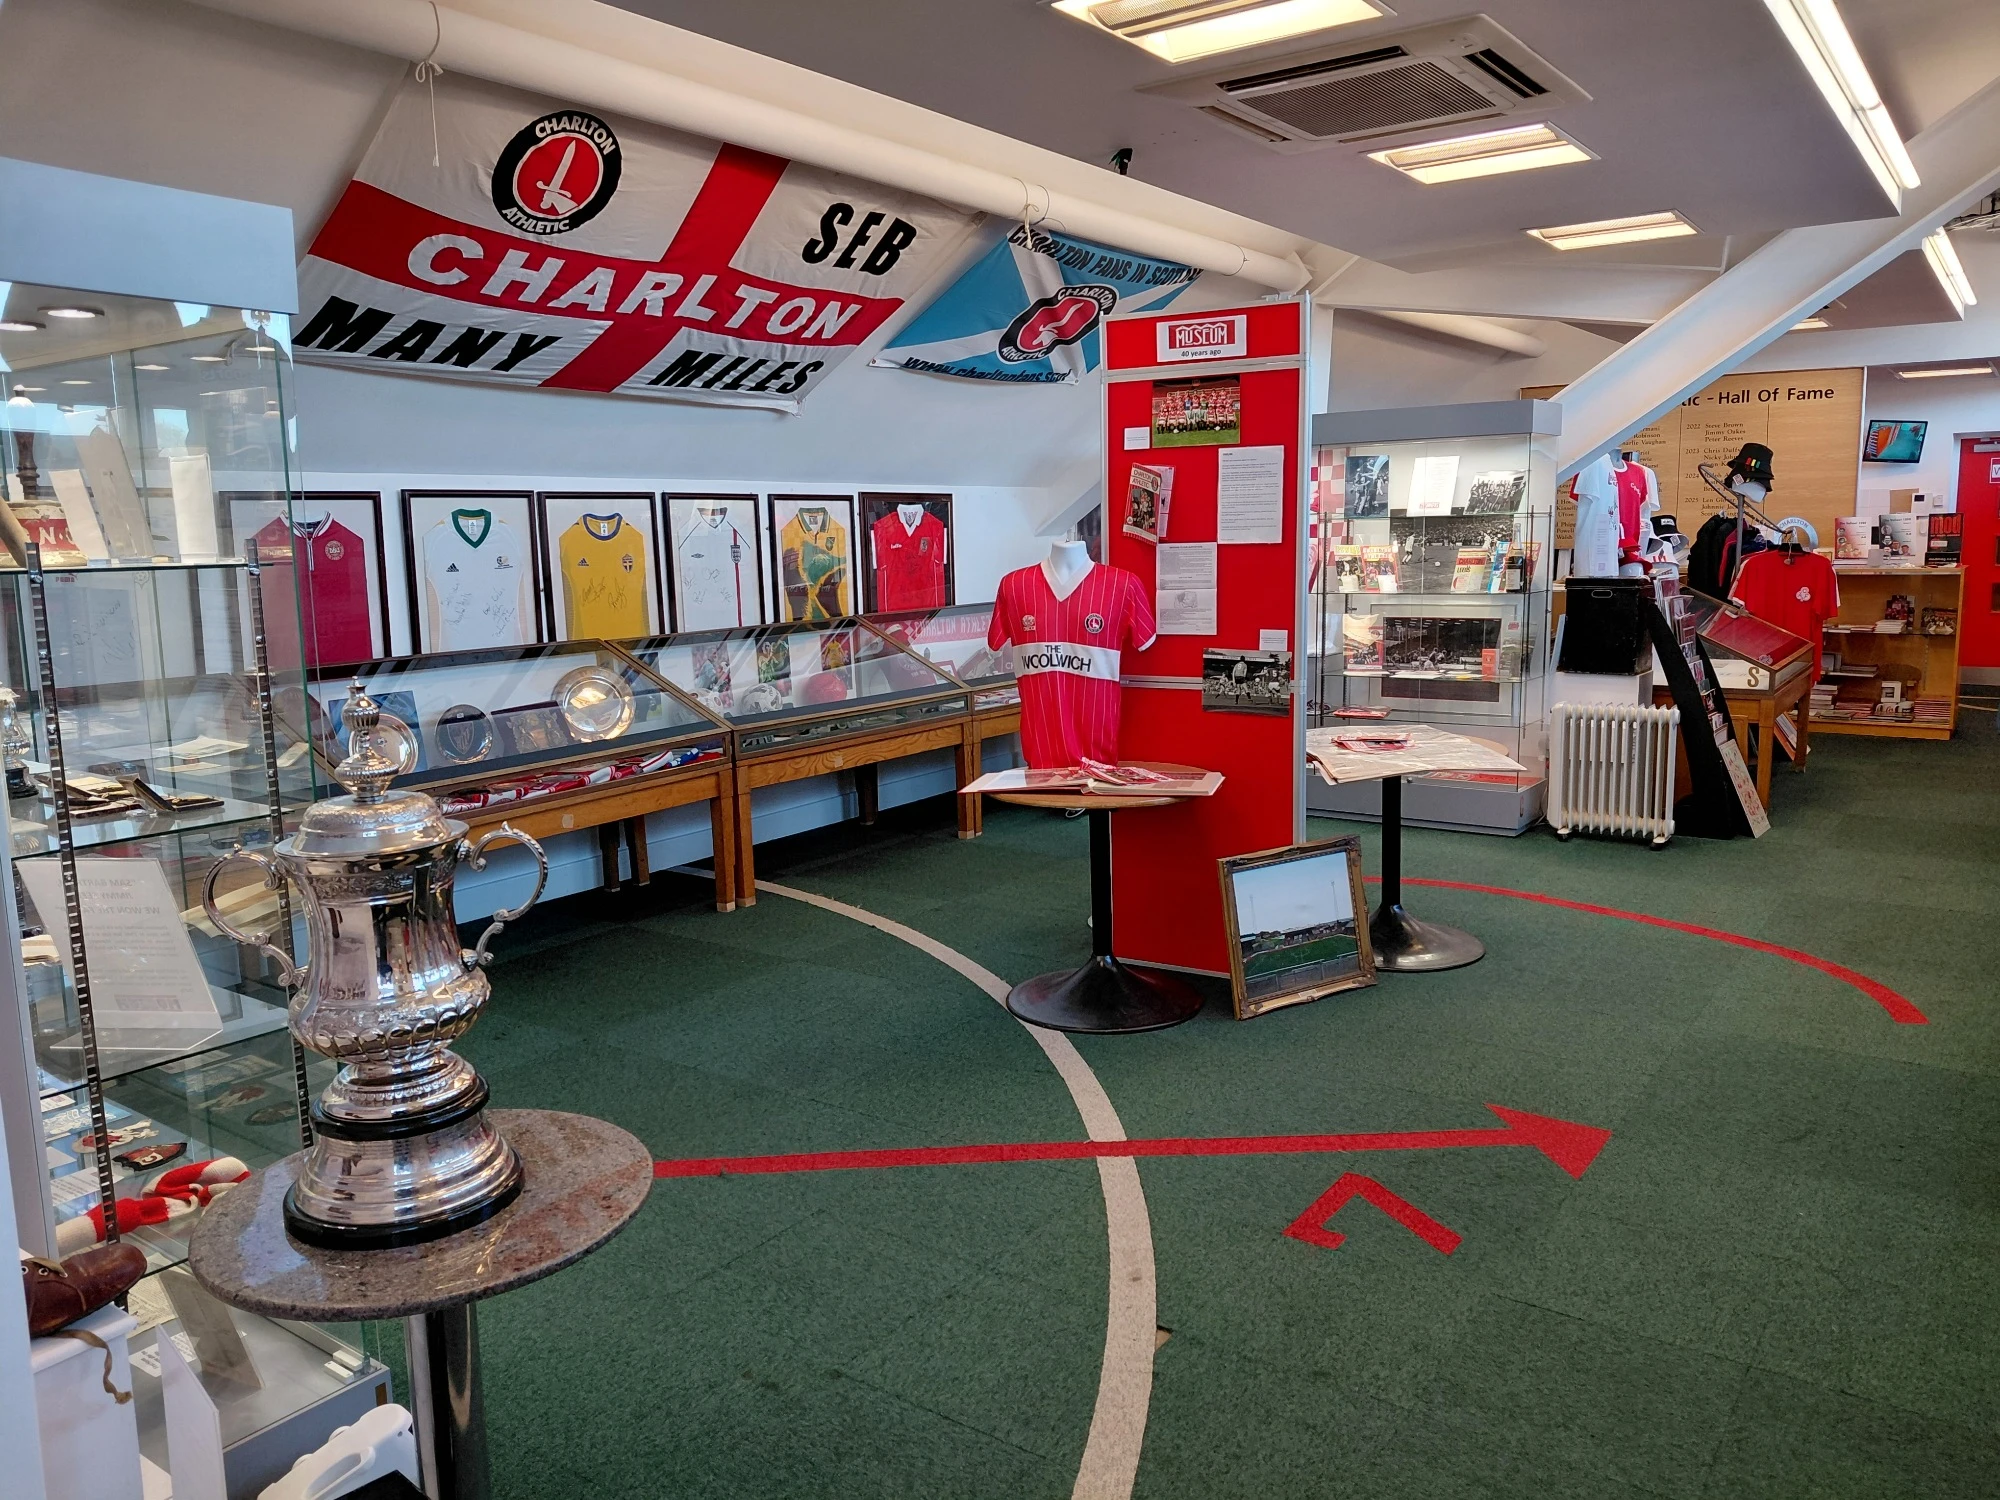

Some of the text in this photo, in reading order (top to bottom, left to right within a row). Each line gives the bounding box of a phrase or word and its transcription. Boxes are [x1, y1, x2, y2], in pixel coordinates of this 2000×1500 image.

[535, 115, 616, 156] CHARLTON
[501, 206, 570, 234] ATHLETIC
[802, 200, 917, 276] SEB
[1007, 225, 1096, 271] CHARLTON
[1088, 254, 1133, 281] FANS
[1127, 262, 1152, 283] IN
[406, 233, 862, 341] CHARLTON
[1057, 287, 1114, 311] CHARLTON
[292, 295, 562, 373] MANY
[1175, 323, 1228, 348] MUSEUM
[1001, 345, 1047, 361] ATHLETIC
[1190, 350, 1208, 358] years
[1209, 349, 1222, 357] ago
[647, 349, 826, 395] MILES
[1719, 390, 1750, 405] Hall
[1758, 388, 1780, 402] Of
[1788, 387, 1835, 401] Fame
[1779, 518, 1809, 529] CHARLTON
[1045, 645, 1062, 653] THE
[1021, 654, 1092, 672] WOOLWICH
[1747, 666, 1760, 688] S
